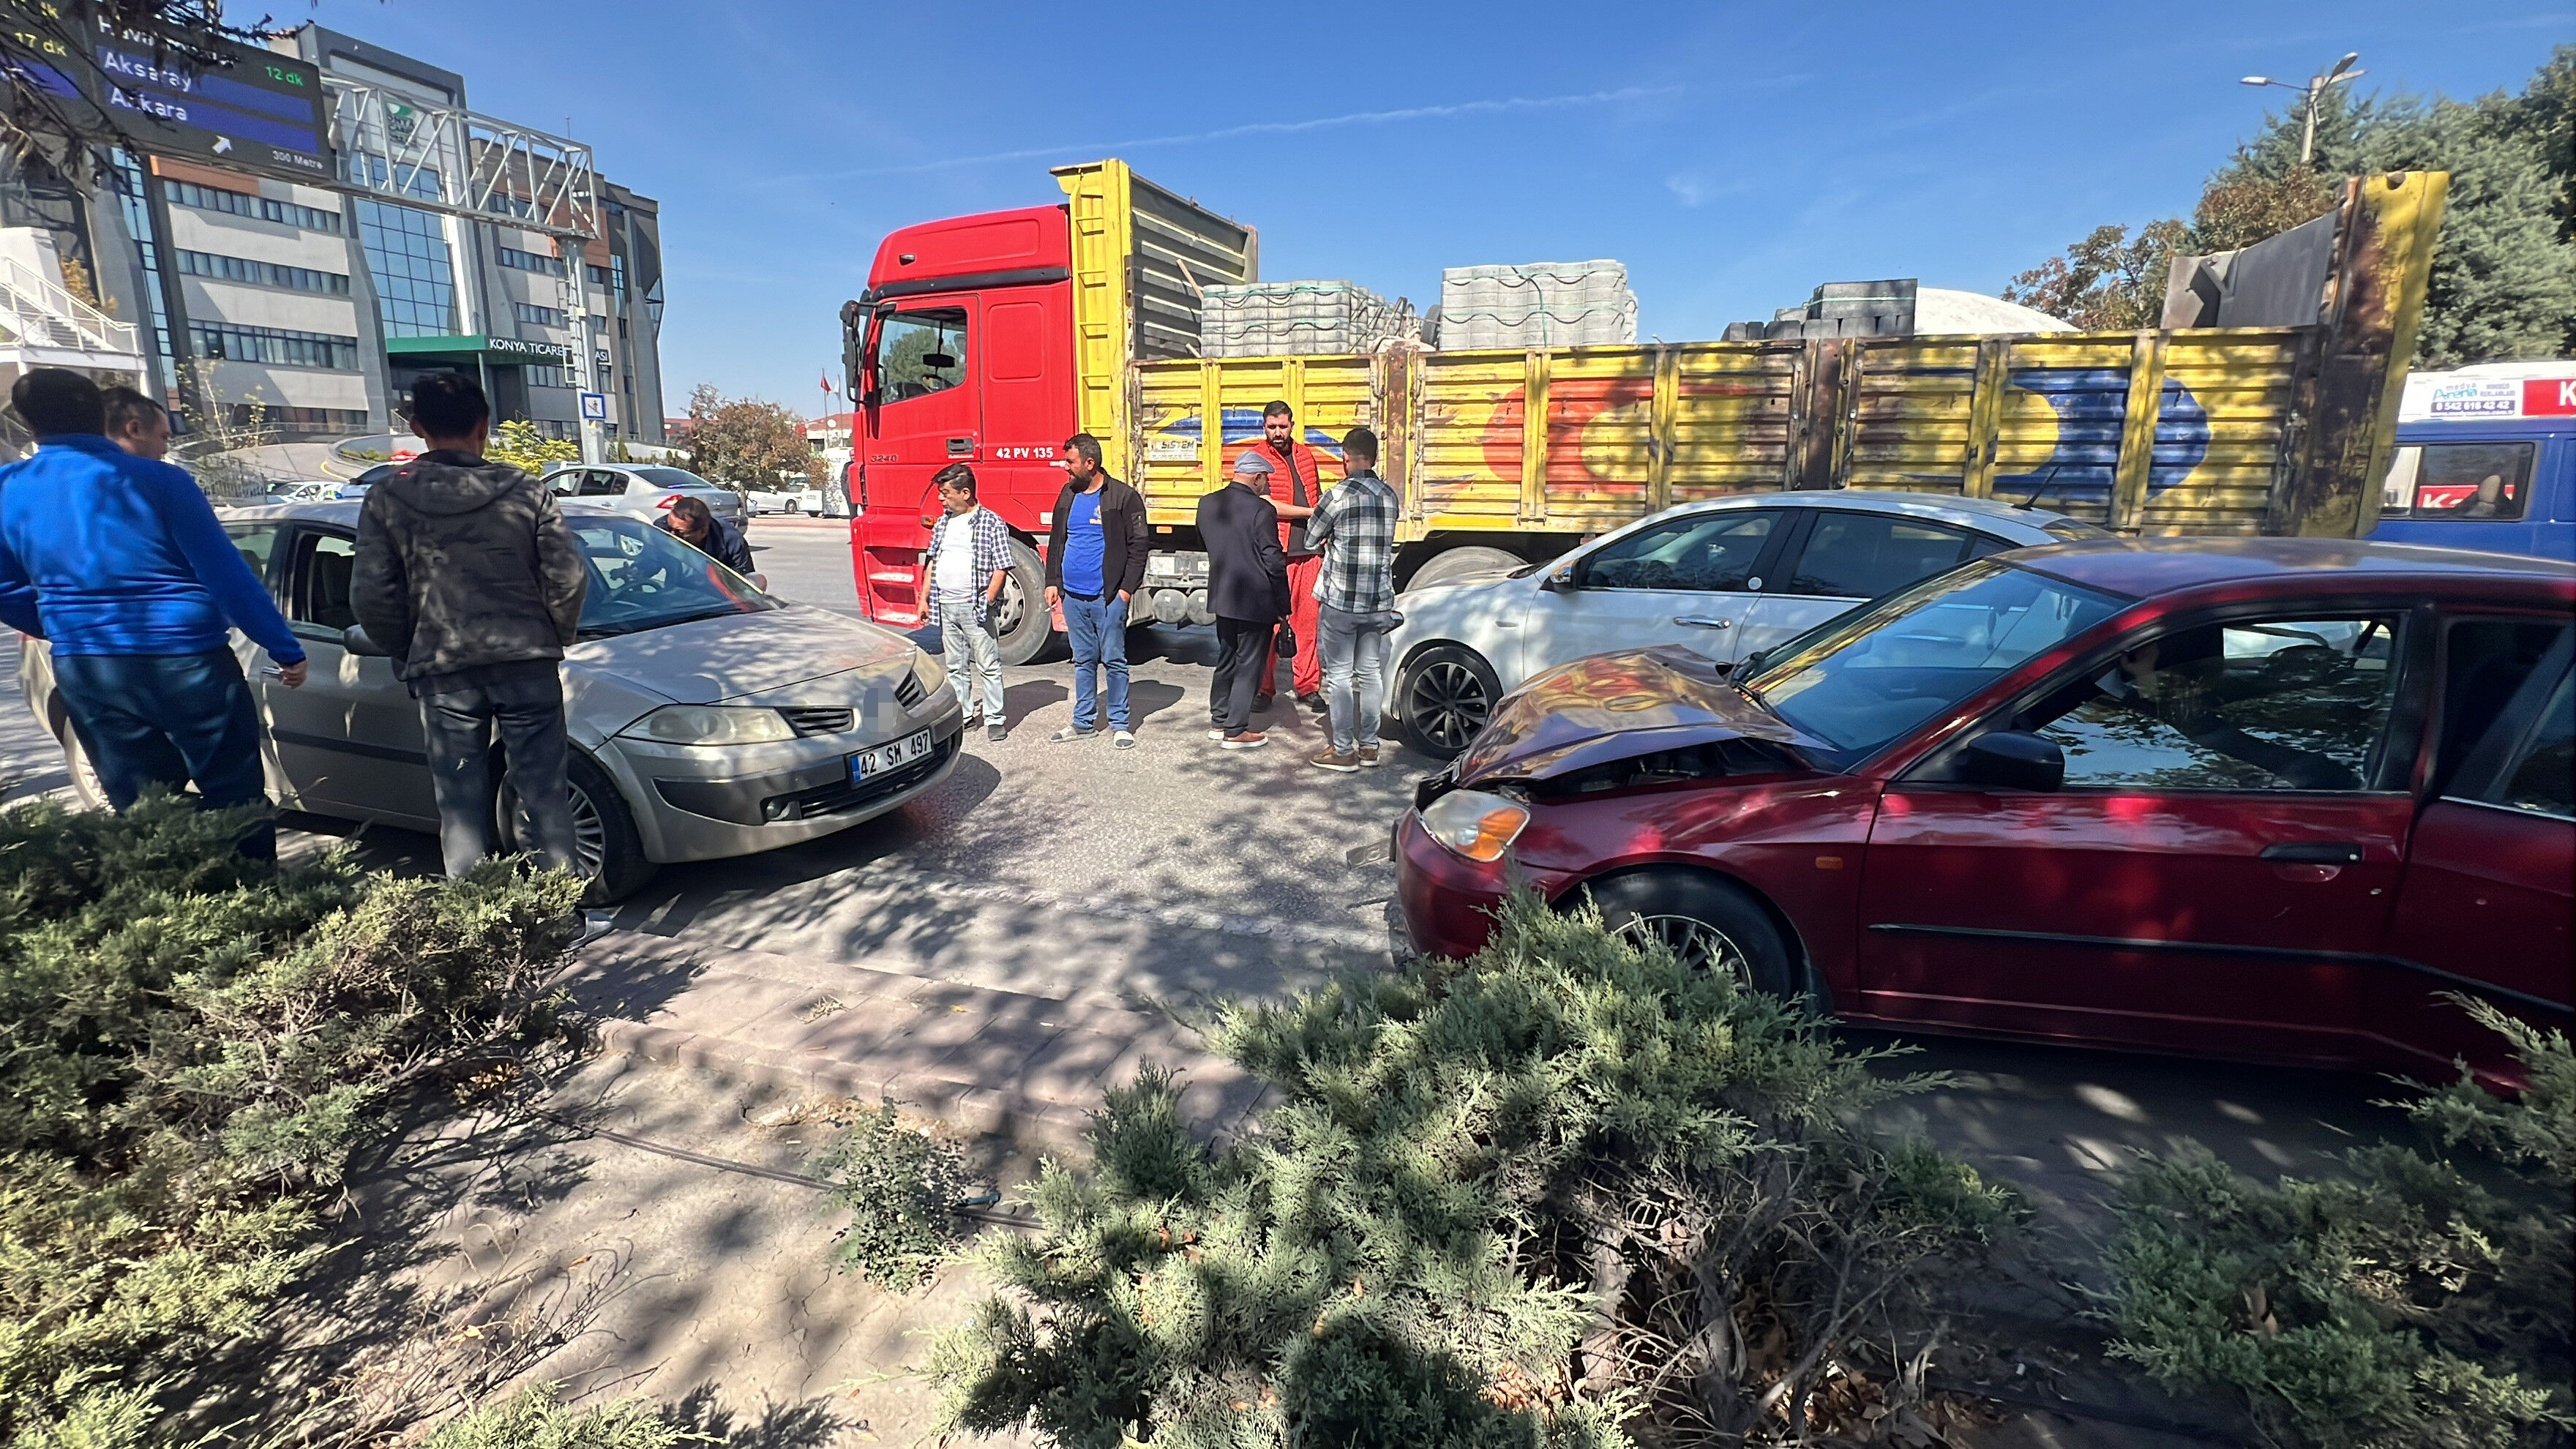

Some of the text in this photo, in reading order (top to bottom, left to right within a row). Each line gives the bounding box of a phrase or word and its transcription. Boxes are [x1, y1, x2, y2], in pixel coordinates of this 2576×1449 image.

[15, 32, 67, 57] 17 dk
[266, 66, 304, 86] 12 dk
[111, 87, 187, 121] Akara
[272, 150, 323, 169] 300 Metre
[489, 338, 527, 353] KONYA
[2433, 389, 2478, 401] Arena
[2483, 401, 2496, 410] 42
[871, 454, 897, 463] 3240
[996, 446, 1054, 459] 42 PV 135
[861, 732, 928, 775] 42 SM 497
